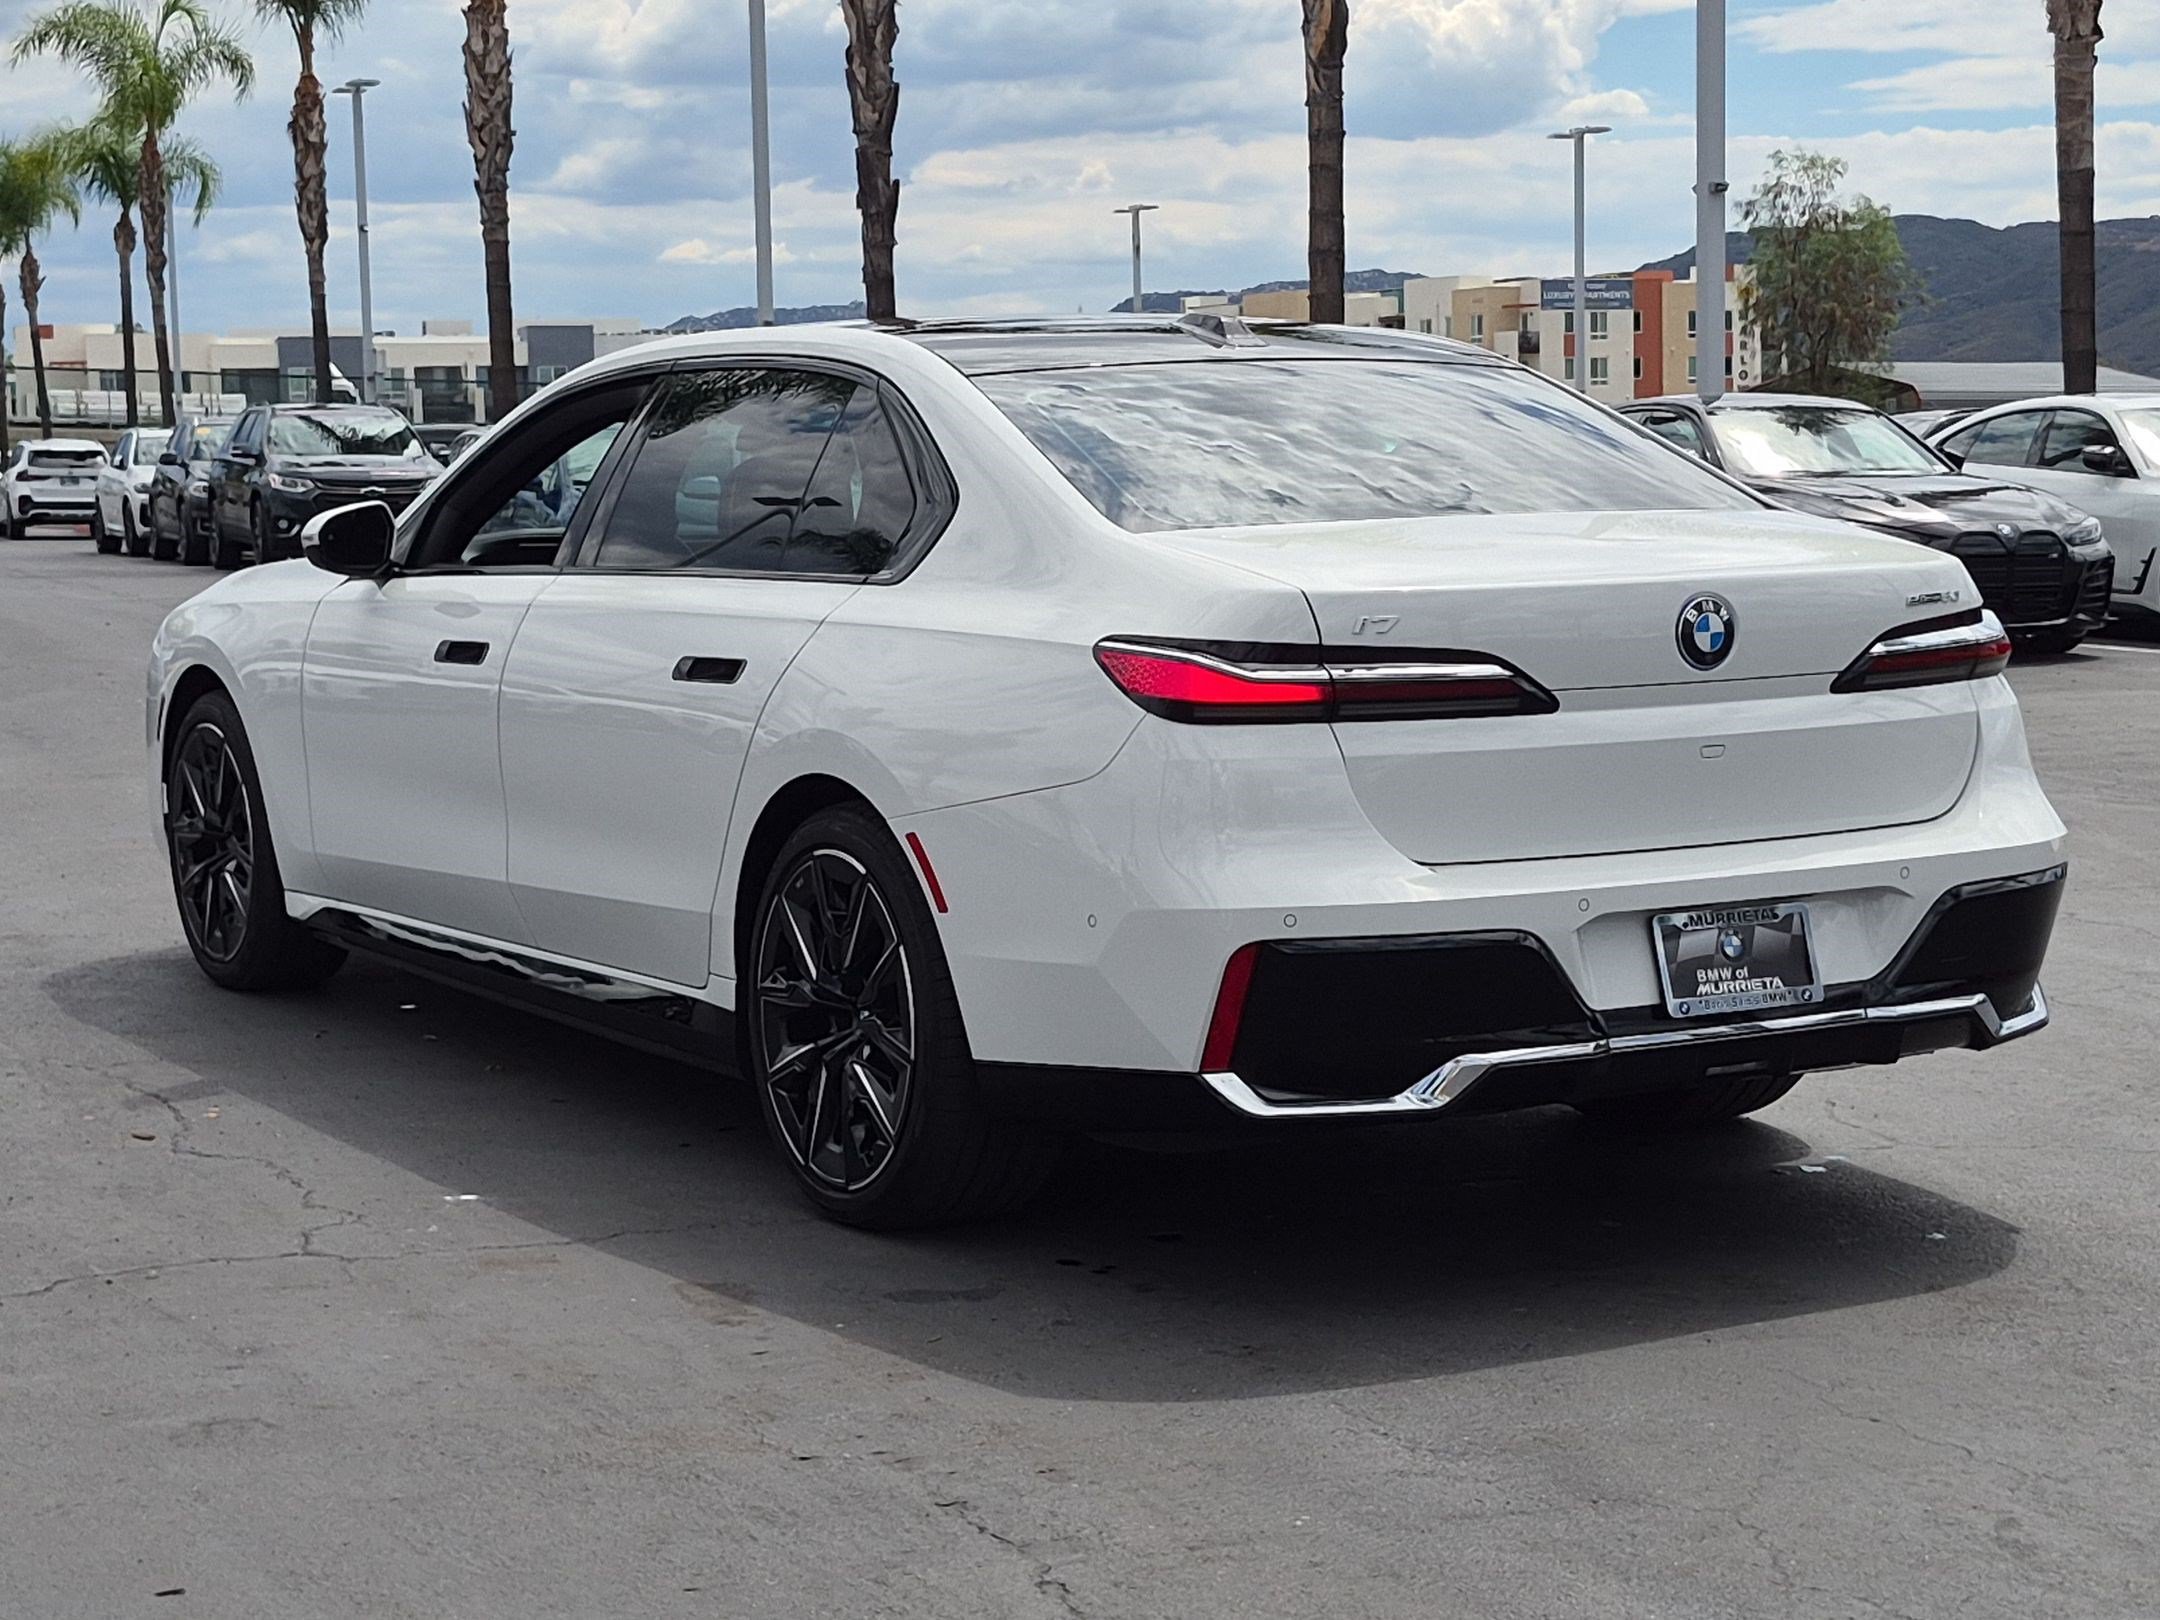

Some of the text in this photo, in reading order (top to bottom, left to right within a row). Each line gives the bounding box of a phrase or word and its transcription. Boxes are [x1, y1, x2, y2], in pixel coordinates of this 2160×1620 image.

[1686, 600, 1730, 623] BMW
[1696, 965, 1749, 983] BMW of
[1696, 975, 1785, 996] MURRIETA
